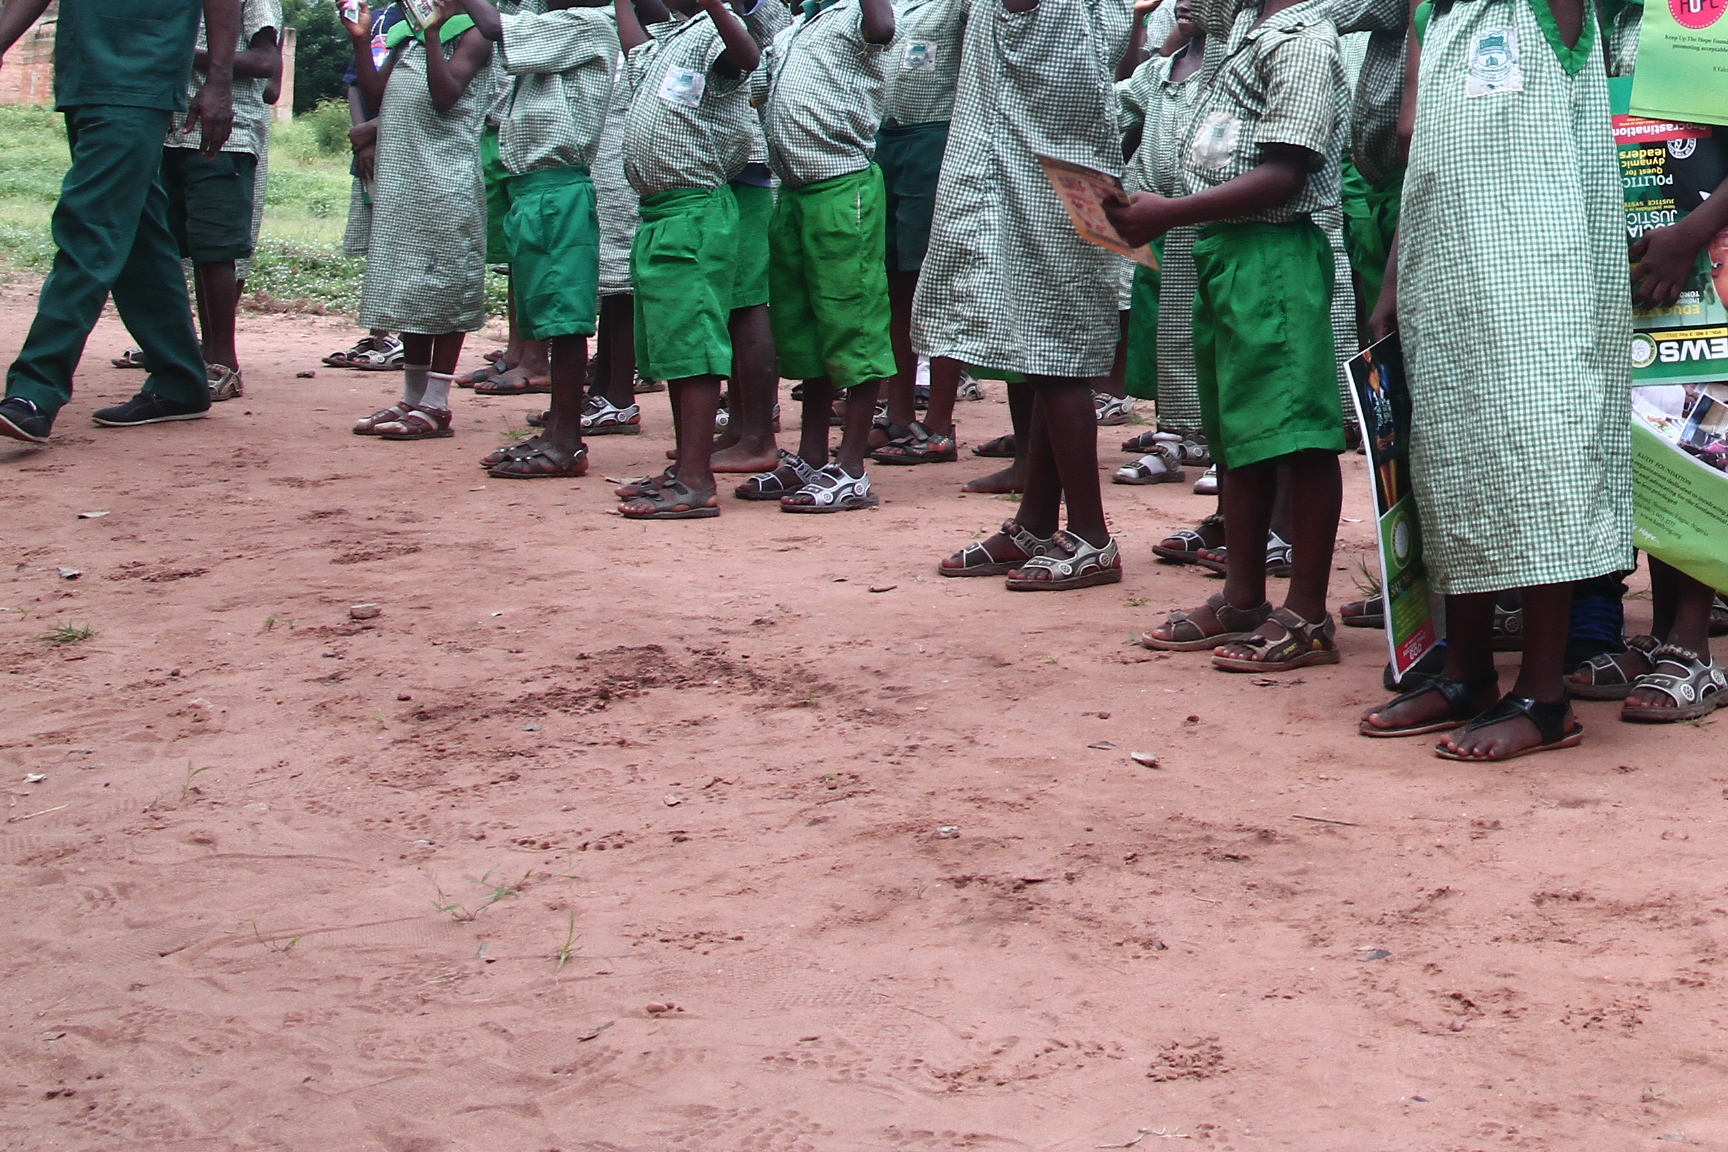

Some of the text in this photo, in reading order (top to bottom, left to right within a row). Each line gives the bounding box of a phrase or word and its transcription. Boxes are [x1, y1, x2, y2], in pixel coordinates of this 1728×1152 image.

[1619, 146, 1665, 162] leaders
[1621, 155, 1664, 168] dynamic
[1638, 166, 1662, 175] Quest
[1620, 172, 1672, 190] POLITIC
[1647, 197, 1673, 205] JUSTICE
[1626, 208, 1677, 226] JUSTIC
[1637, 452, 1691, 485] KUTH FOUNDATION
